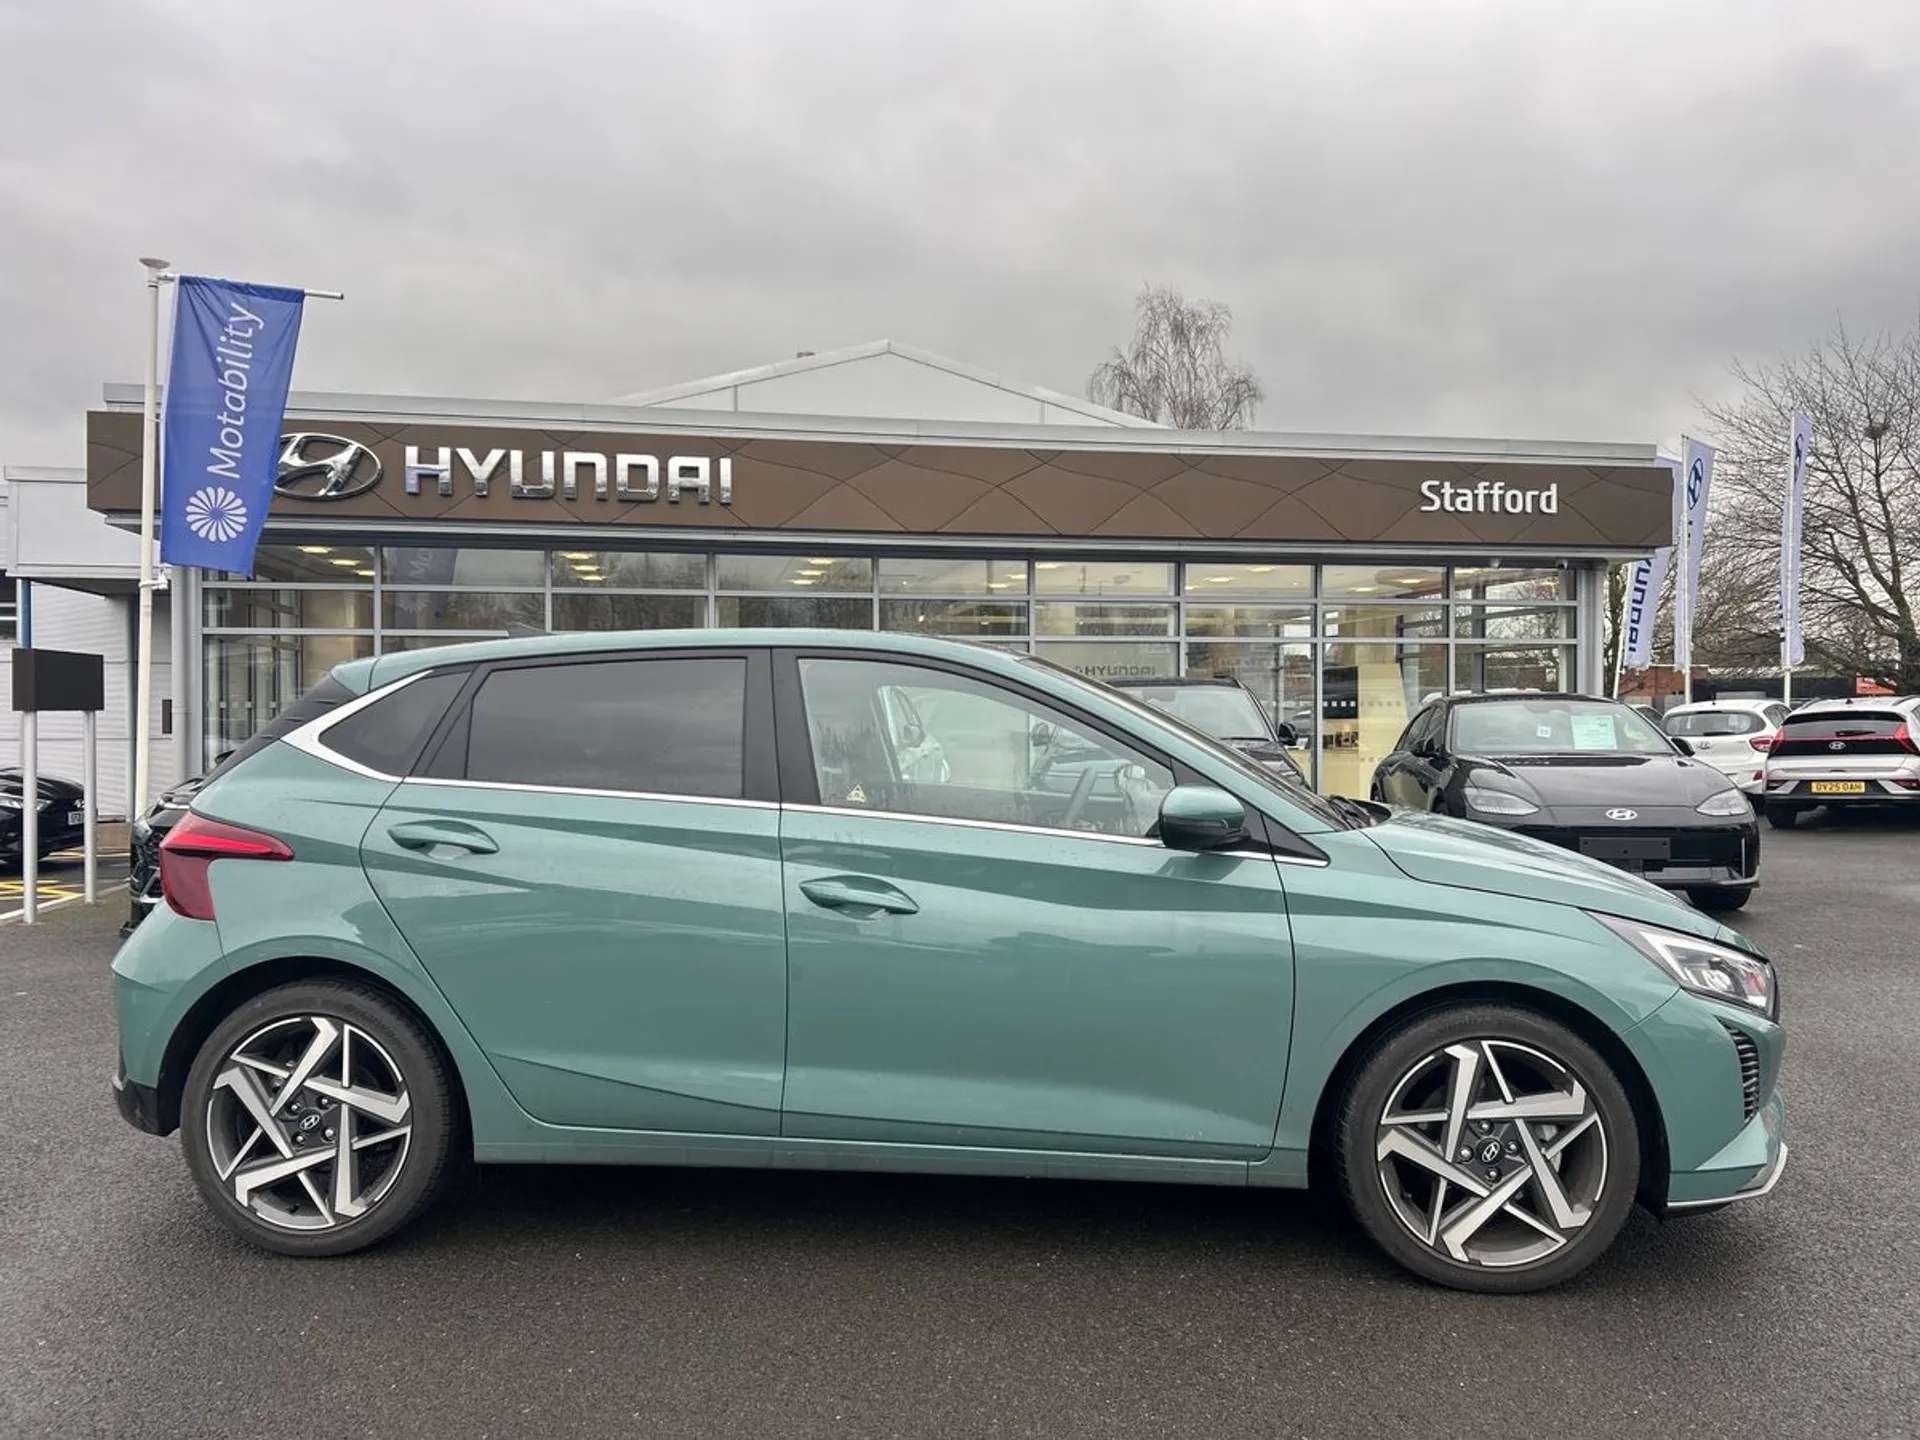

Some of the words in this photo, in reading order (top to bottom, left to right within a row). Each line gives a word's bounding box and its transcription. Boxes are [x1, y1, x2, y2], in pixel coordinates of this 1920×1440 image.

[206, 302, 264, 478] Motability
[404, 445, 734, 506] HYUNDAI
[1420, 480, 1558, 514] Stafford
[1085, 665, 1156, 676] HYUNDAI
